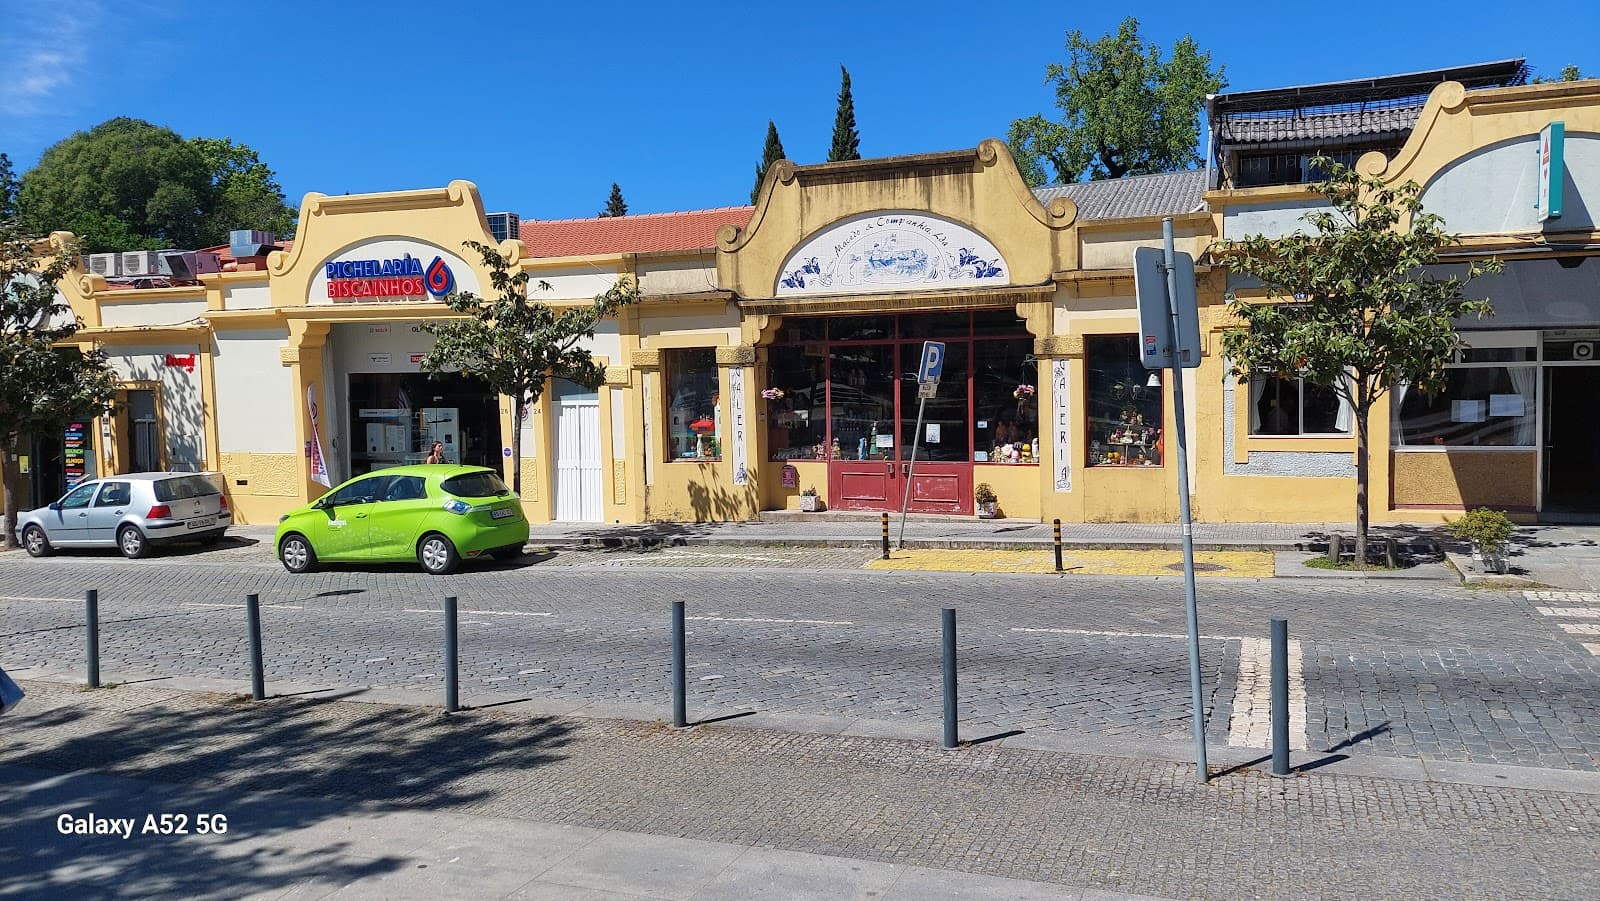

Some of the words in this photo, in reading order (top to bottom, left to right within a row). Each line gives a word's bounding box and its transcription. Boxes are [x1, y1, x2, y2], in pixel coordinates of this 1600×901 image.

[327, 278, 425, 298] BISCAINHOS
[923, 346, 940, 381] P
[735, 366, 745, 471] GALERIA
[1058, 358, 1069, 481] GALERIA
